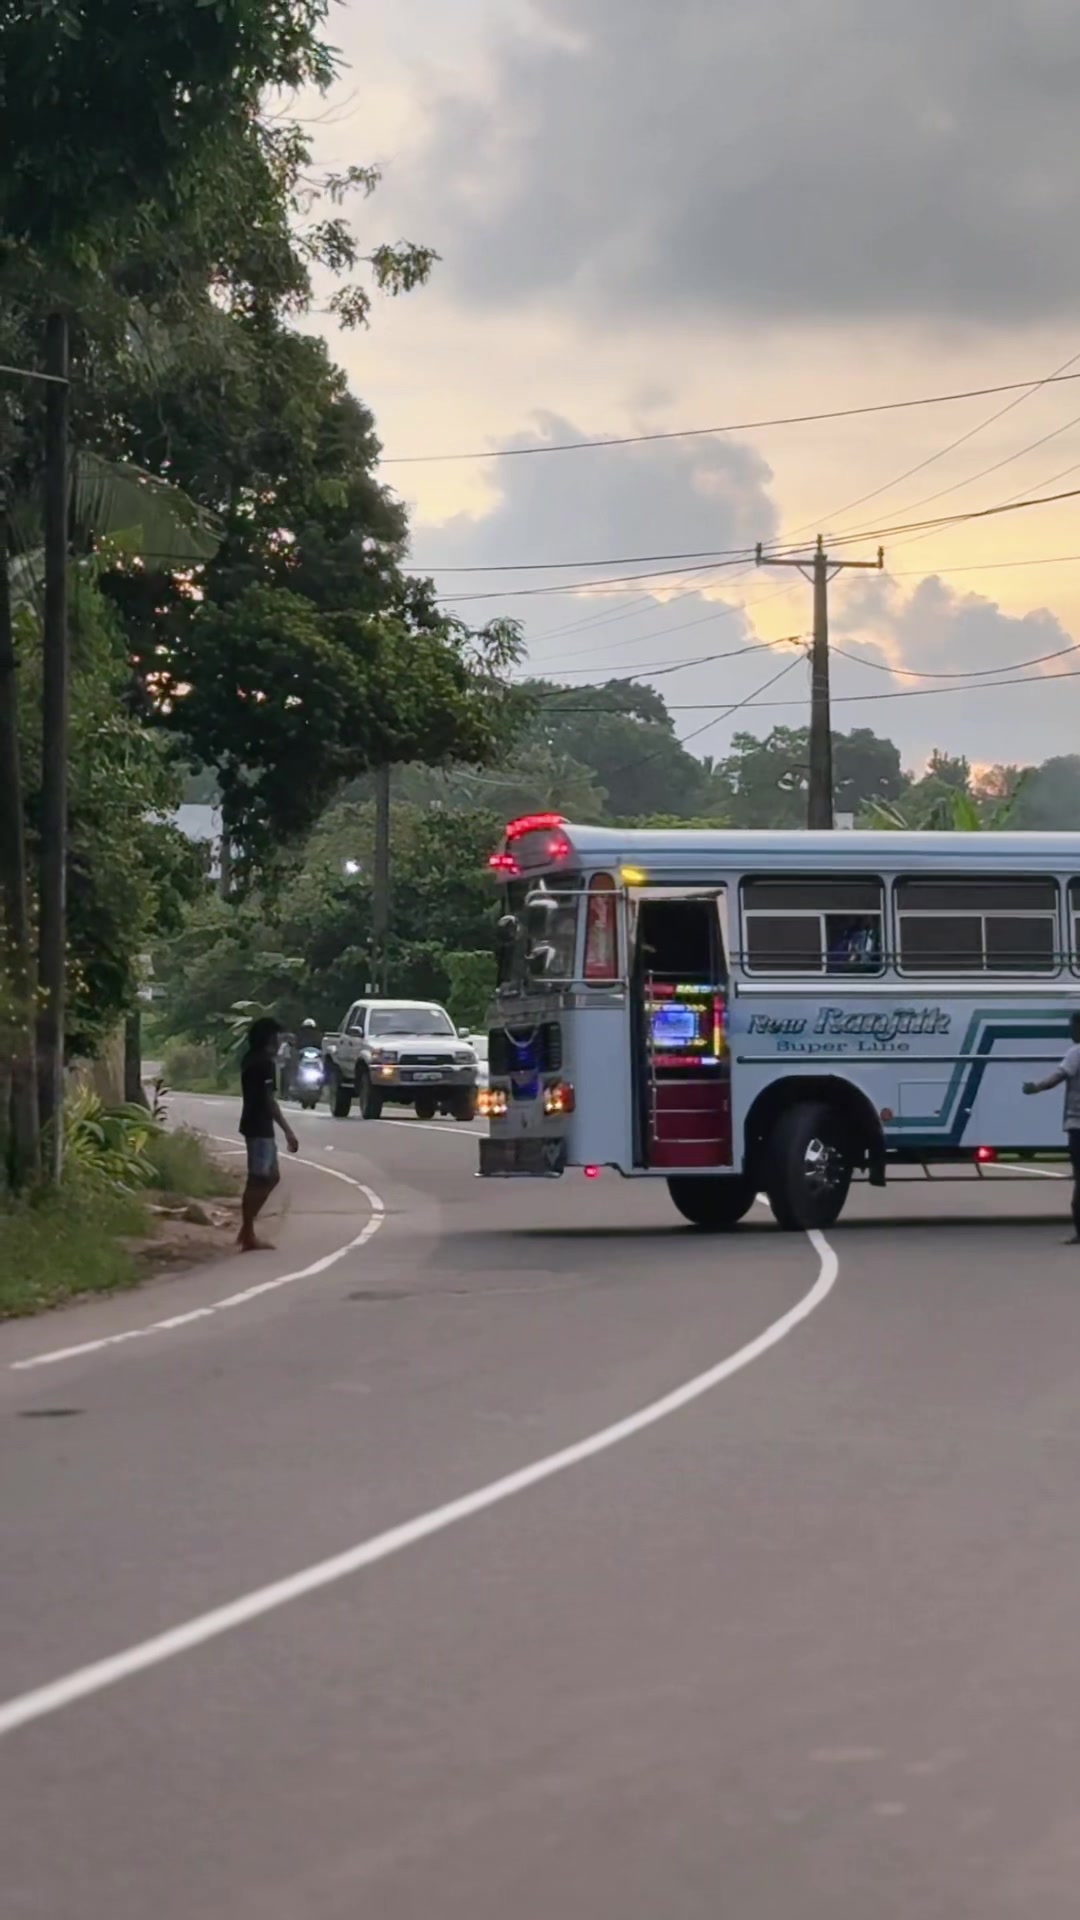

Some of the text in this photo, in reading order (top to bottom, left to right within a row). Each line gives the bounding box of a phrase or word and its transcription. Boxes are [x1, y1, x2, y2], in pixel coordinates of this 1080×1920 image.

[747, 1014, 808, 1035] New
[776, 1040, 910, 1054] Super Line
